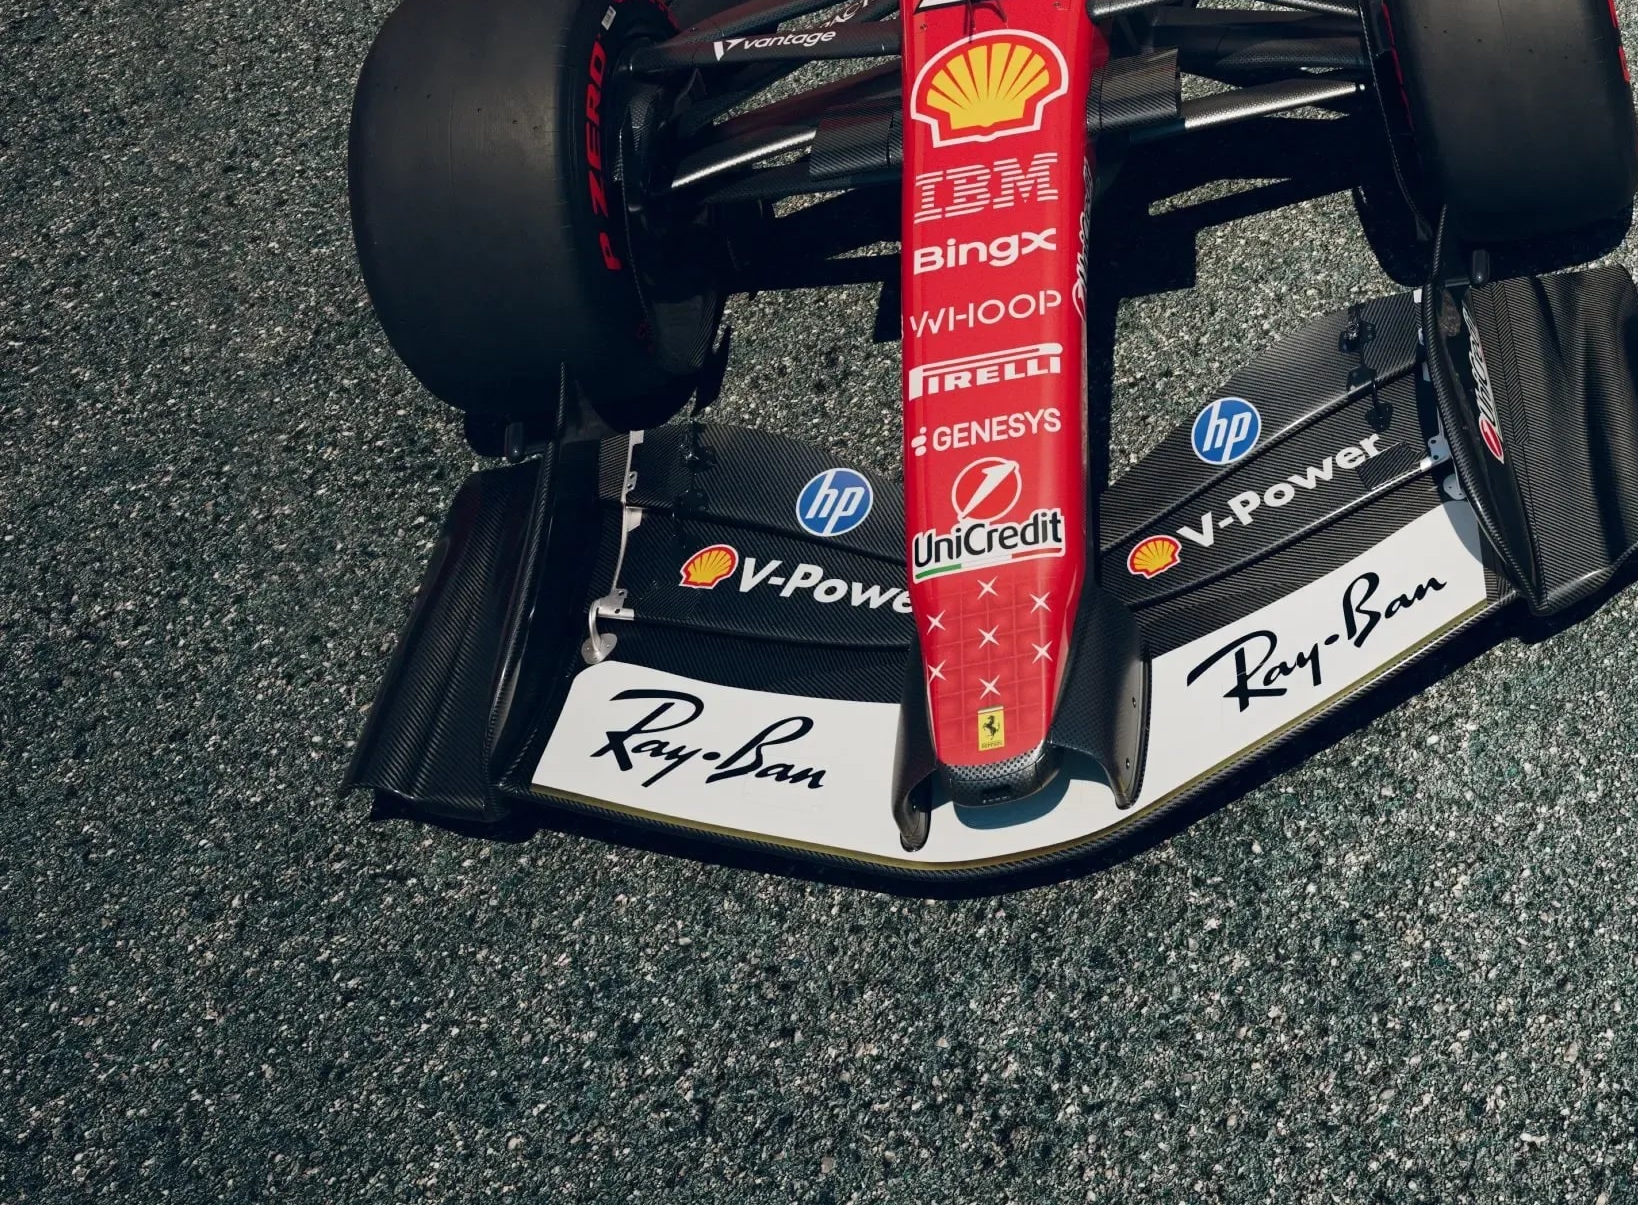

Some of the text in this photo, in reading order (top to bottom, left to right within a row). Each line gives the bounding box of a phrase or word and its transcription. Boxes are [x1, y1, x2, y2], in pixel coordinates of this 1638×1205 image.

[744, 30, 837, 47] vantage
[913, 152, 1059, 224] IBM
[909, 289, 1062, 338] WHOOP
[908, 343, 1063, 401] PIRELLI
[932, 407, 1062, 452] GENESYS
[1194, 398, 1258, 464] hp
[804, 468, 866, 536] hp
[1176, 432, 1382, 549] V-Power
[913, 511, 1063, 569] UniCredit
[739, 557, 913, 614] V-Powe
[1187, 572, 1446, 712] Ray-Ban
[589, 688, 827, 789] Ray-Ban
